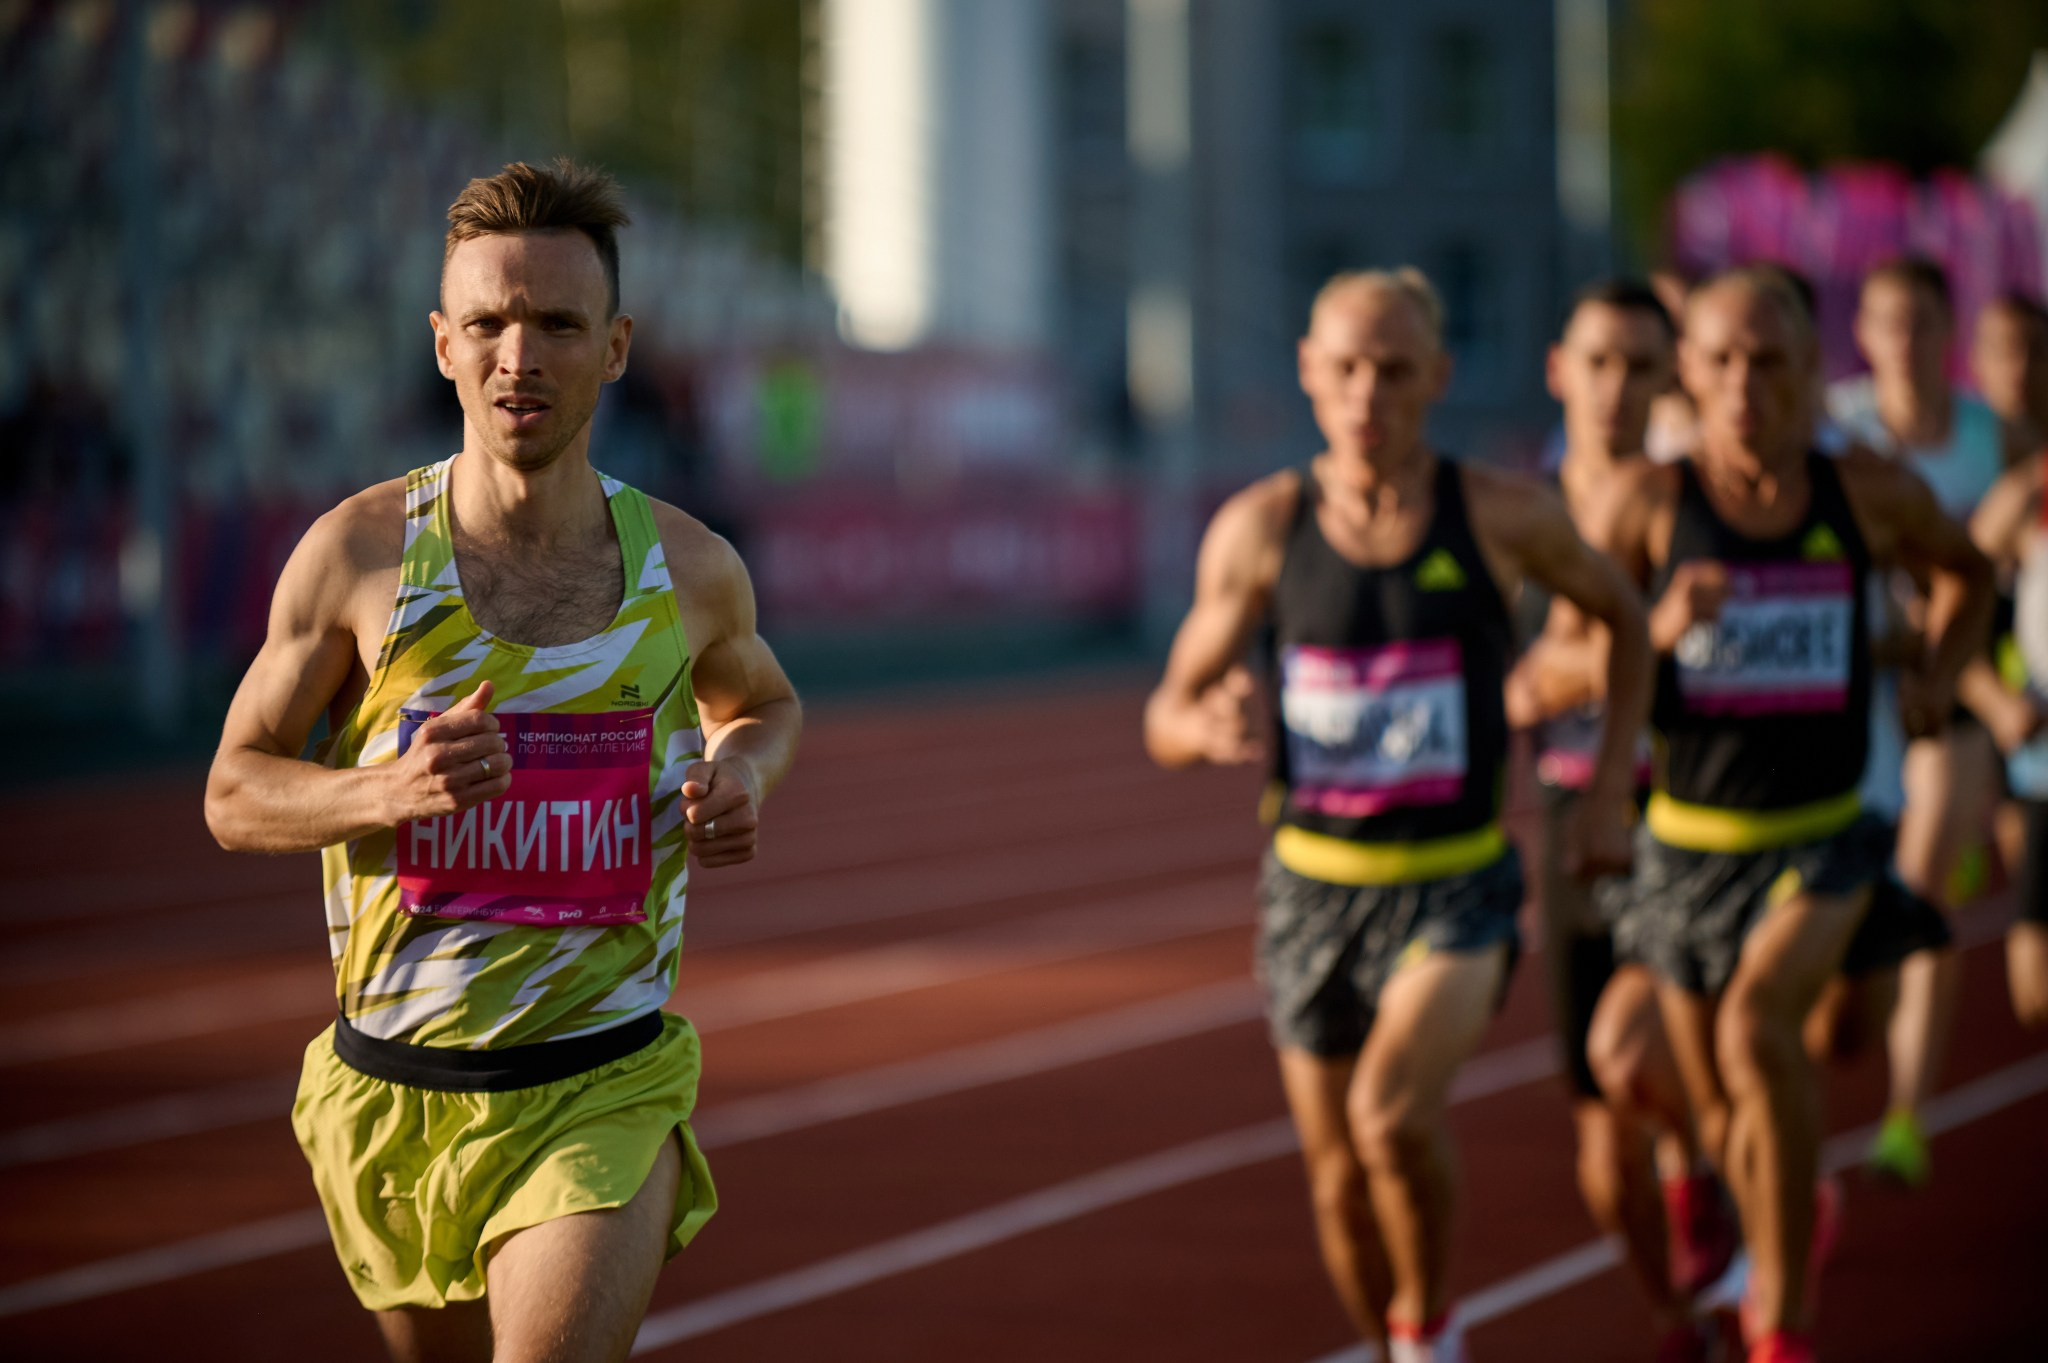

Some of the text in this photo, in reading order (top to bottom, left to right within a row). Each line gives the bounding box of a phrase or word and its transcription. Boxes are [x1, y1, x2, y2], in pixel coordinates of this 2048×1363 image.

[519, 732, 598, 743] ЧЕМПИОНАТ
[600, 728, 648, 742] РОССИИ
[518, 739, 646, 755] ПО ЛЕГКОЙ АТЛЕТИКЕ
[411, 794, 640, 872] НИКИТИН
[434, 904, 507, 917] ЕКАТЕРИНБУРГ
